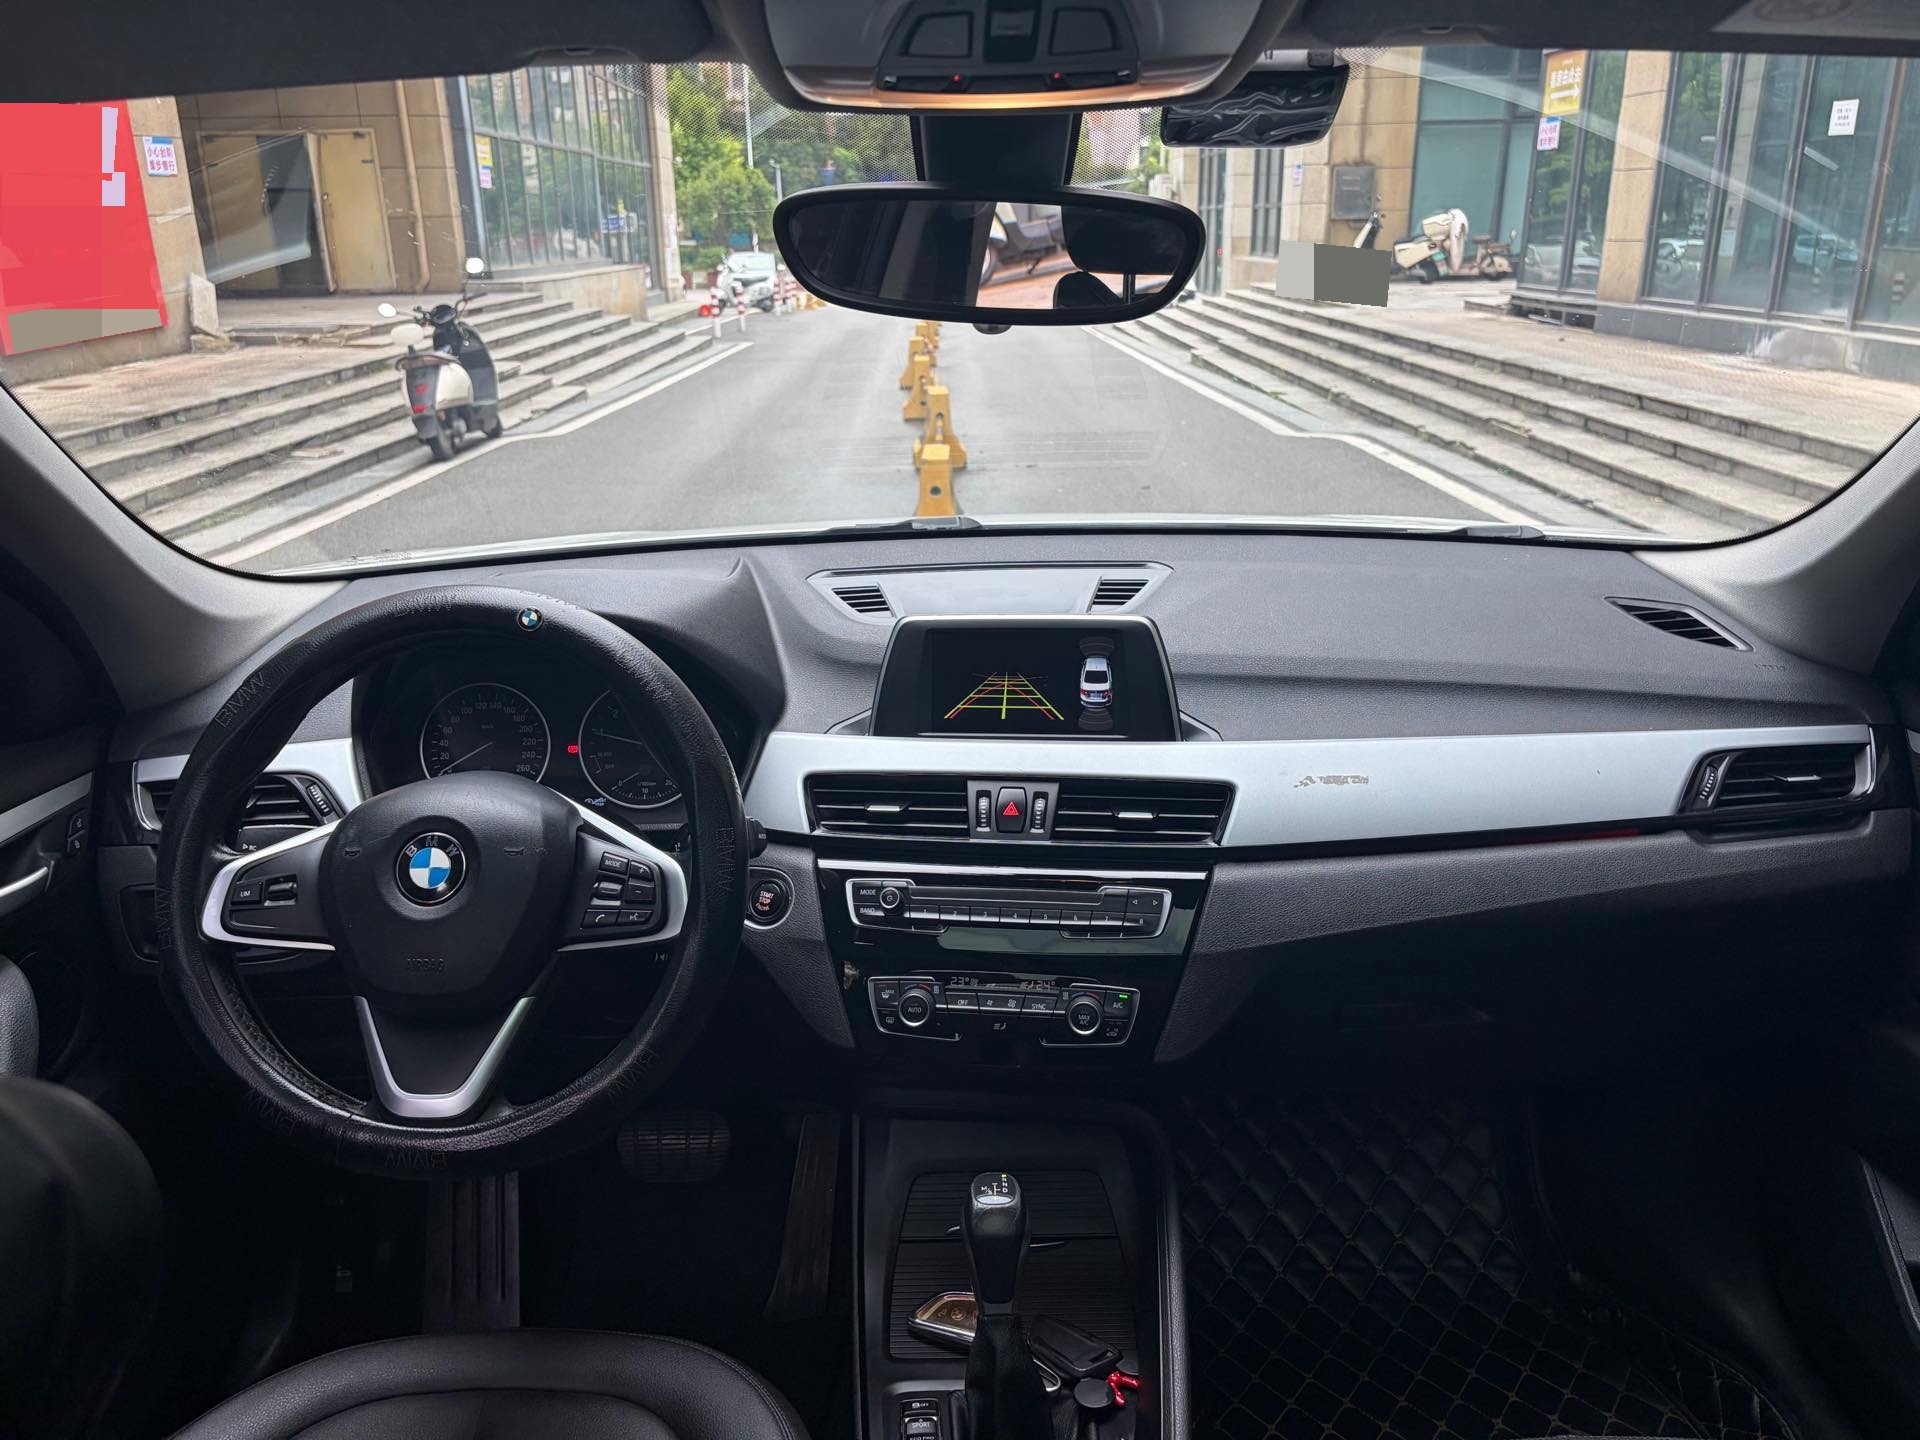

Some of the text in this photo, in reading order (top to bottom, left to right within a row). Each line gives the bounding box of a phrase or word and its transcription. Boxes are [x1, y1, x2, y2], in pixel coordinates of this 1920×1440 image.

[516, 764, 530, 772] 260
[405, 835, 460, 858] BMW
[604, 859, 622, 868] MODE
[760, 890, 775, 899] START
[860, 888, 877, 896] MODE
[759, 896, 771, 905] STOP
[1031, 1003, 1046, 1011] SYNC
[911, 1421, 930, 1429] SPORT
